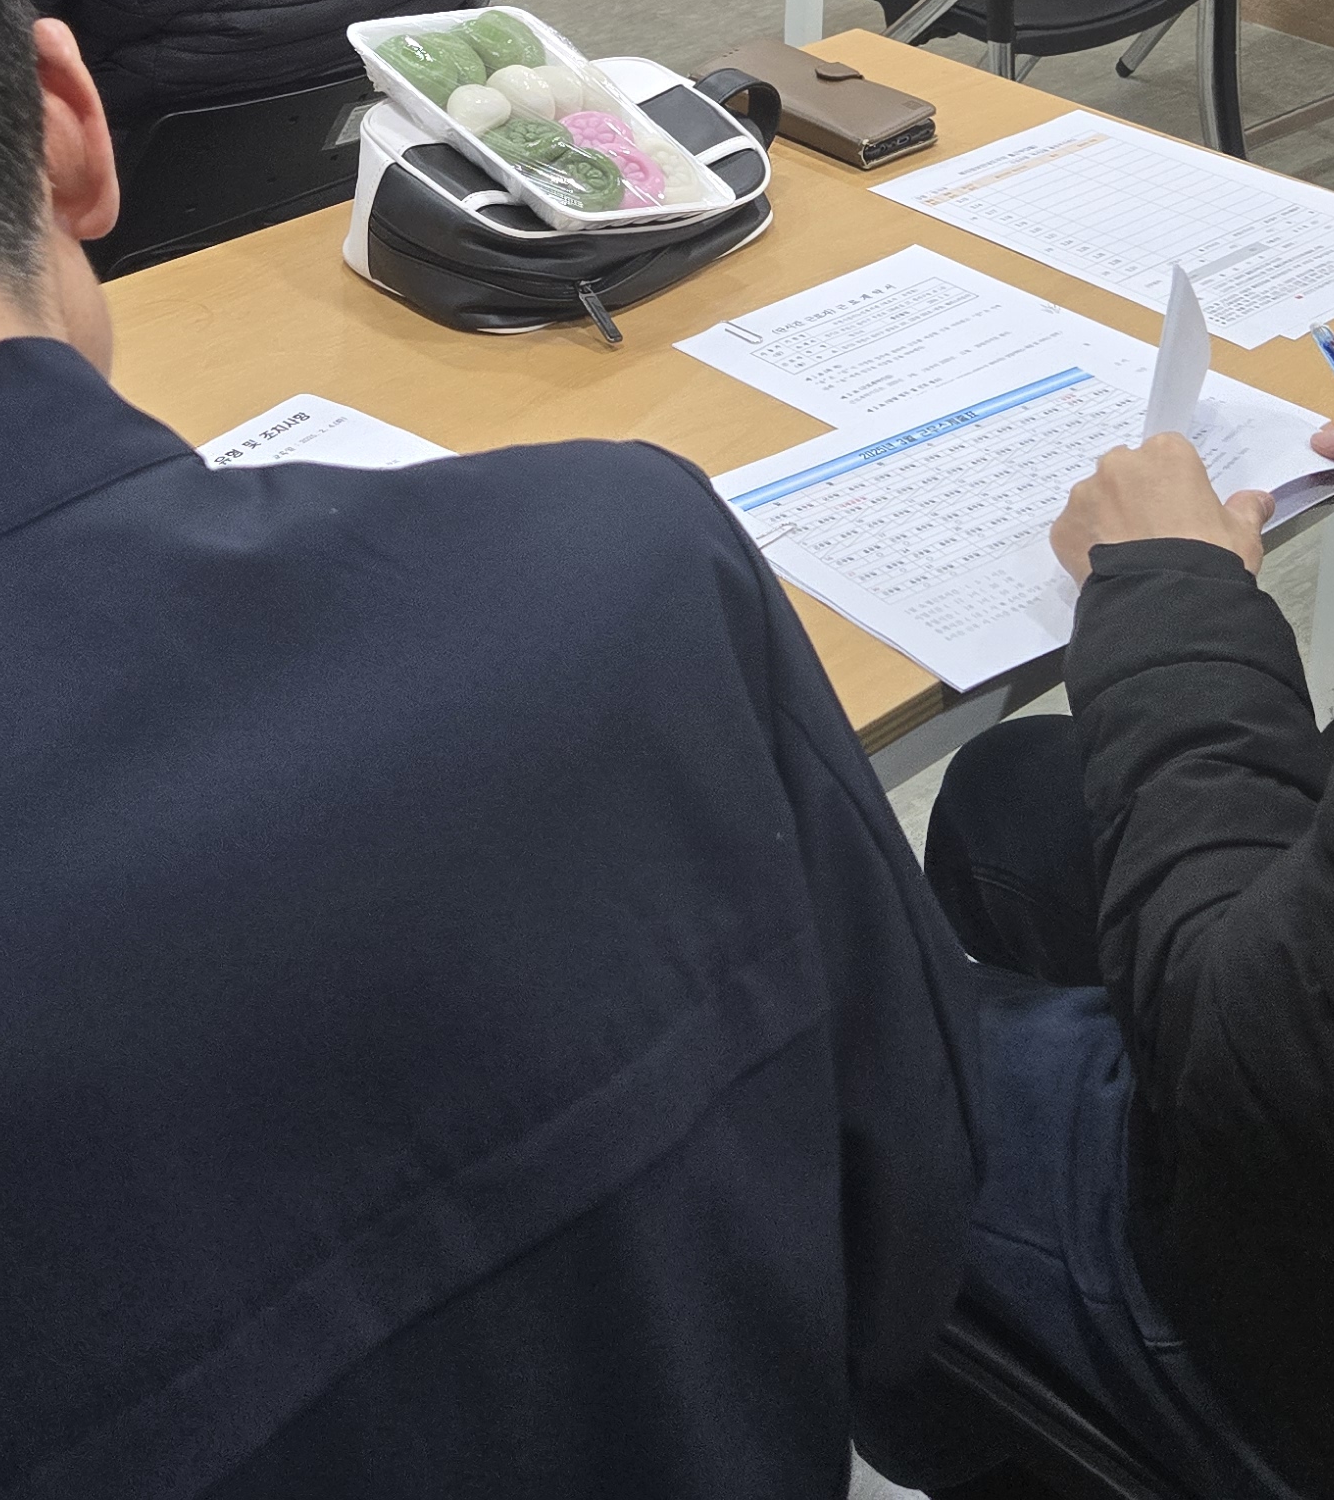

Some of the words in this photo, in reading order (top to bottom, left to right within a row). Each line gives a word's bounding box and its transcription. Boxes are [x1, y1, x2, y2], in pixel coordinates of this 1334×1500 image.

[214, 448, 244, 466] 유형
[242, 438, 262, 450] 및
[259, 411, 311, 441] 조치사항
